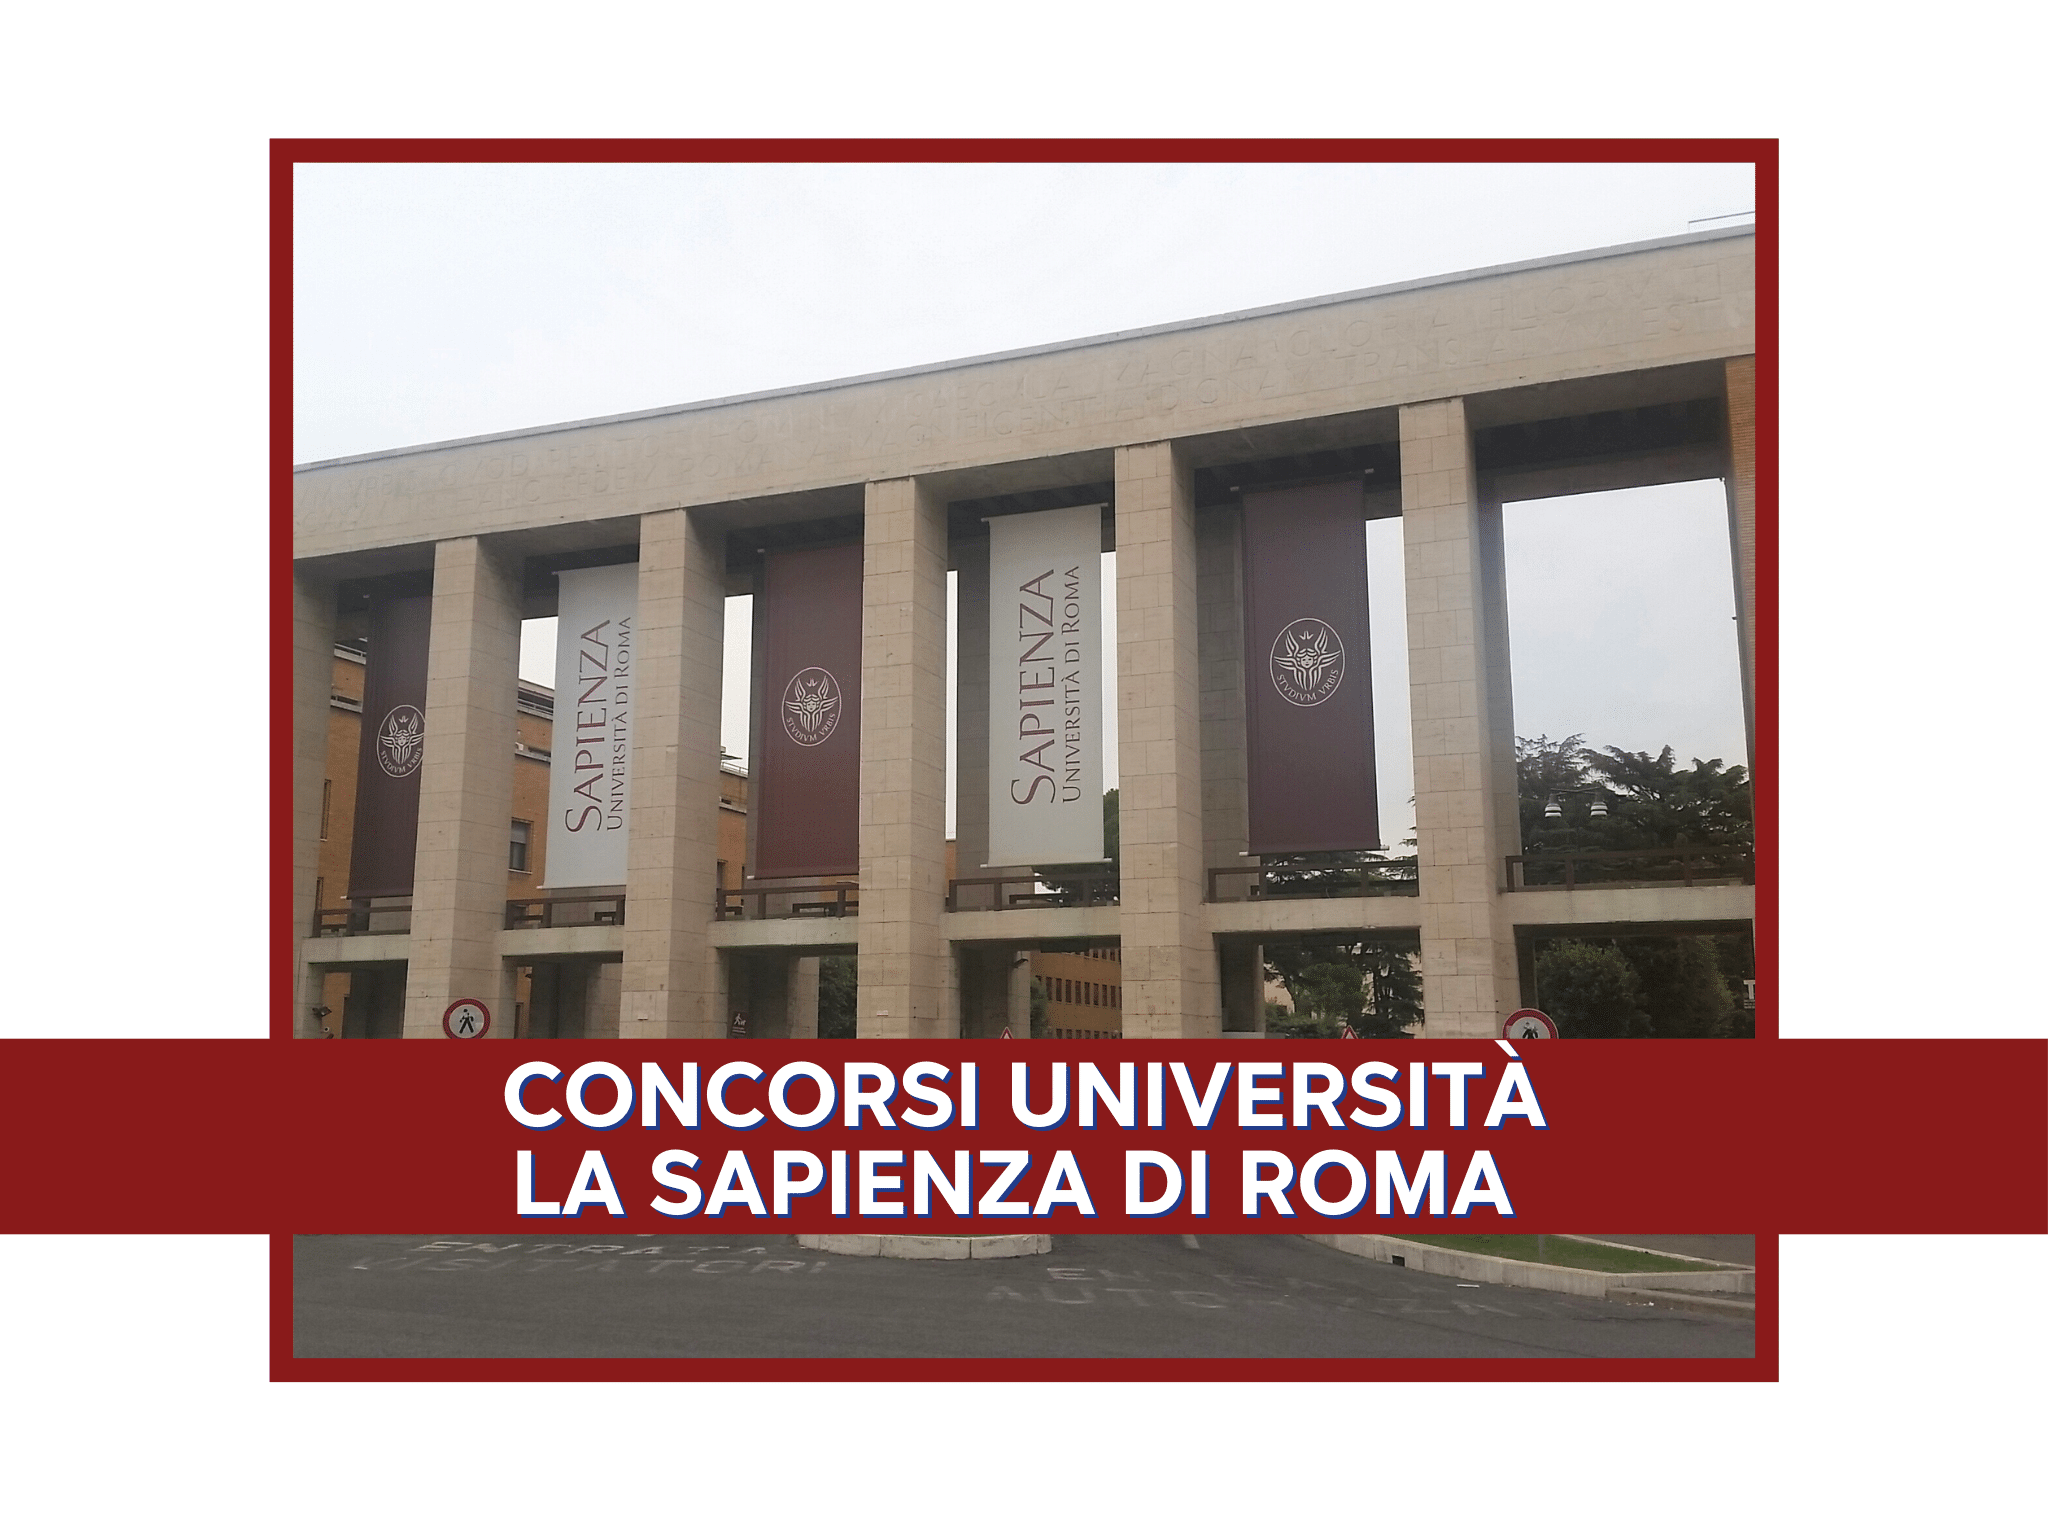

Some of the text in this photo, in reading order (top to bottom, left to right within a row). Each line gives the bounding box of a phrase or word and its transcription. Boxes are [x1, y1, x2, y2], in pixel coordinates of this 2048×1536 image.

[613, 616, 631, 679] ROMA
[1061, 565, 1080, 635] ROMA
[565, 619, 610, 833] SAPIENZA
[1010, 568, 1056, 805] SAPIENZA
[1061, 670, 1081, 804] UNIVERSITÀ
[1276, 668, 1339, 701] STVDIVM VRBIS
[607, 711, 628, 831] UNIVERSITÀ
